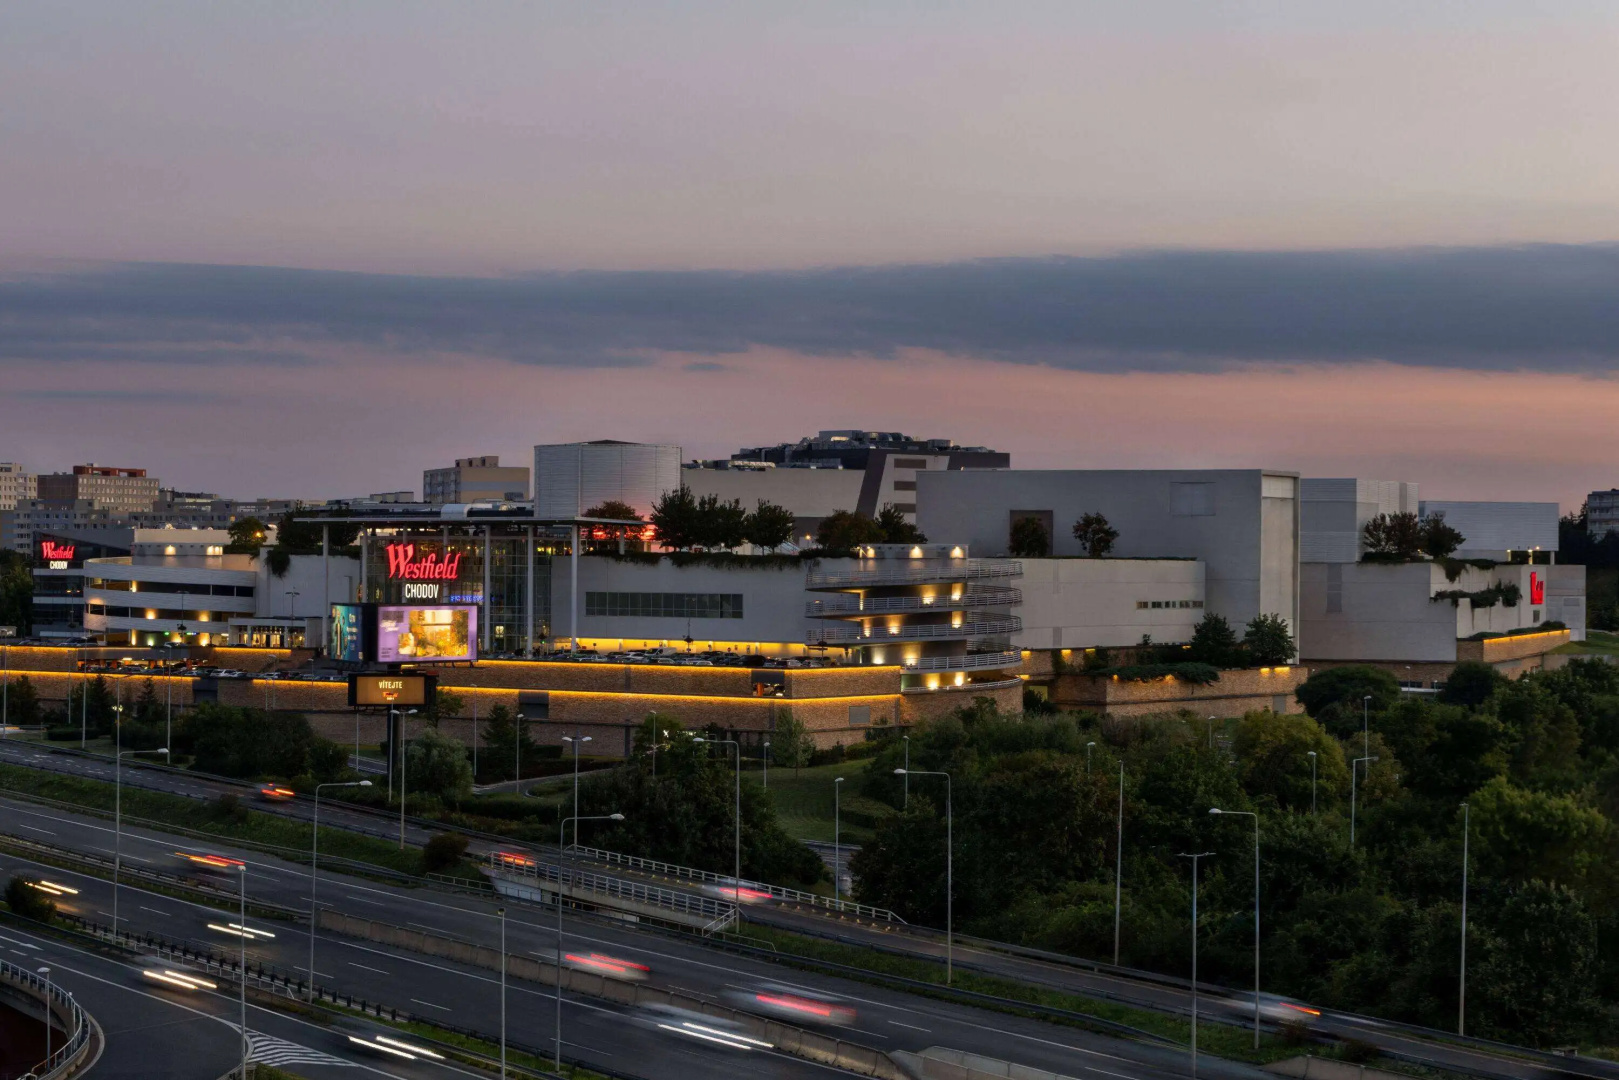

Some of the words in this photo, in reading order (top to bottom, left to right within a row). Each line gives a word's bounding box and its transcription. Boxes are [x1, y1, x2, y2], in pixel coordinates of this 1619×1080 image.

[42, 541, 75, 559] Westfield
[385, 543, 461, 579] Westfield
[405, 583, 439, 598] CHODOV
[378, 680, 402, 689] VÍTEJTE
